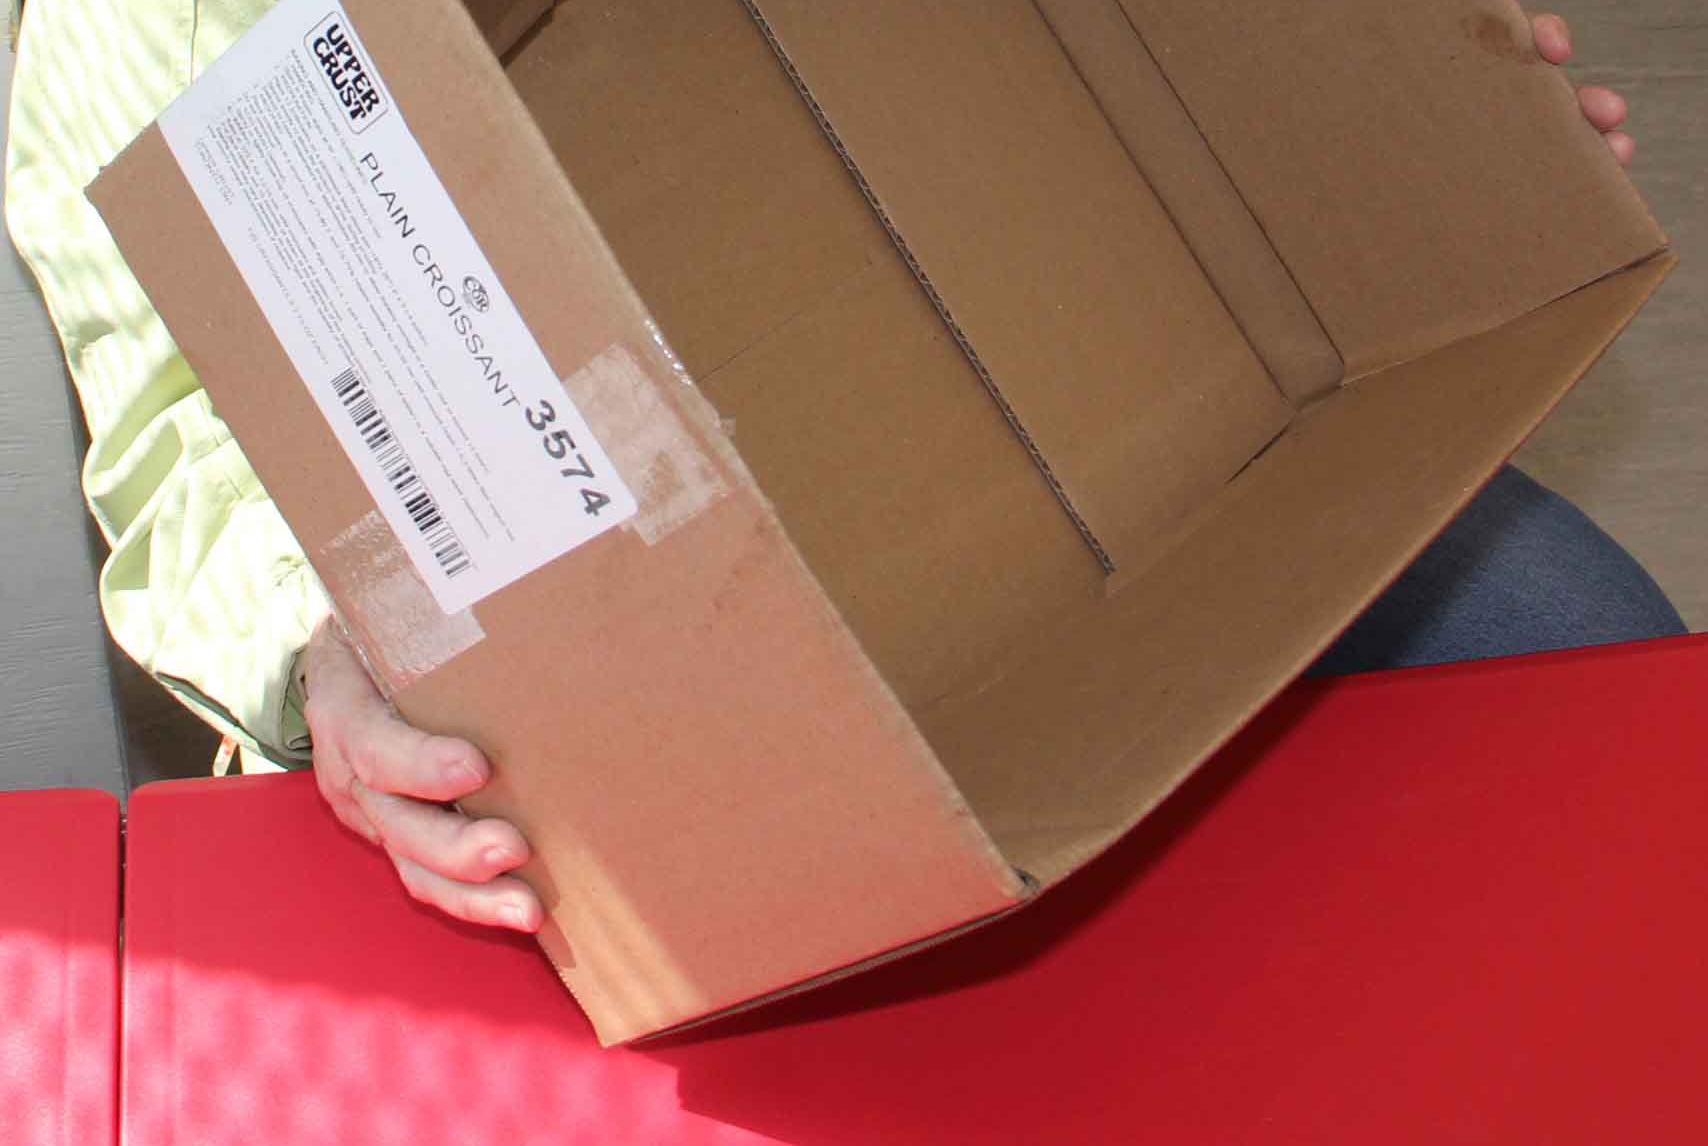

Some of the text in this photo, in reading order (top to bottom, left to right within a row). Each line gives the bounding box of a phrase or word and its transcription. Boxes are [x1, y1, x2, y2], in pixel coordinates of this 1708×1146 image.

[313, 38, 370, 120] CRUST
[327, 24, 380, 112] UPPER
[360, 152, 521, 407] PLAIN CROISSANT
[526, 400, 611, 516] 3574
